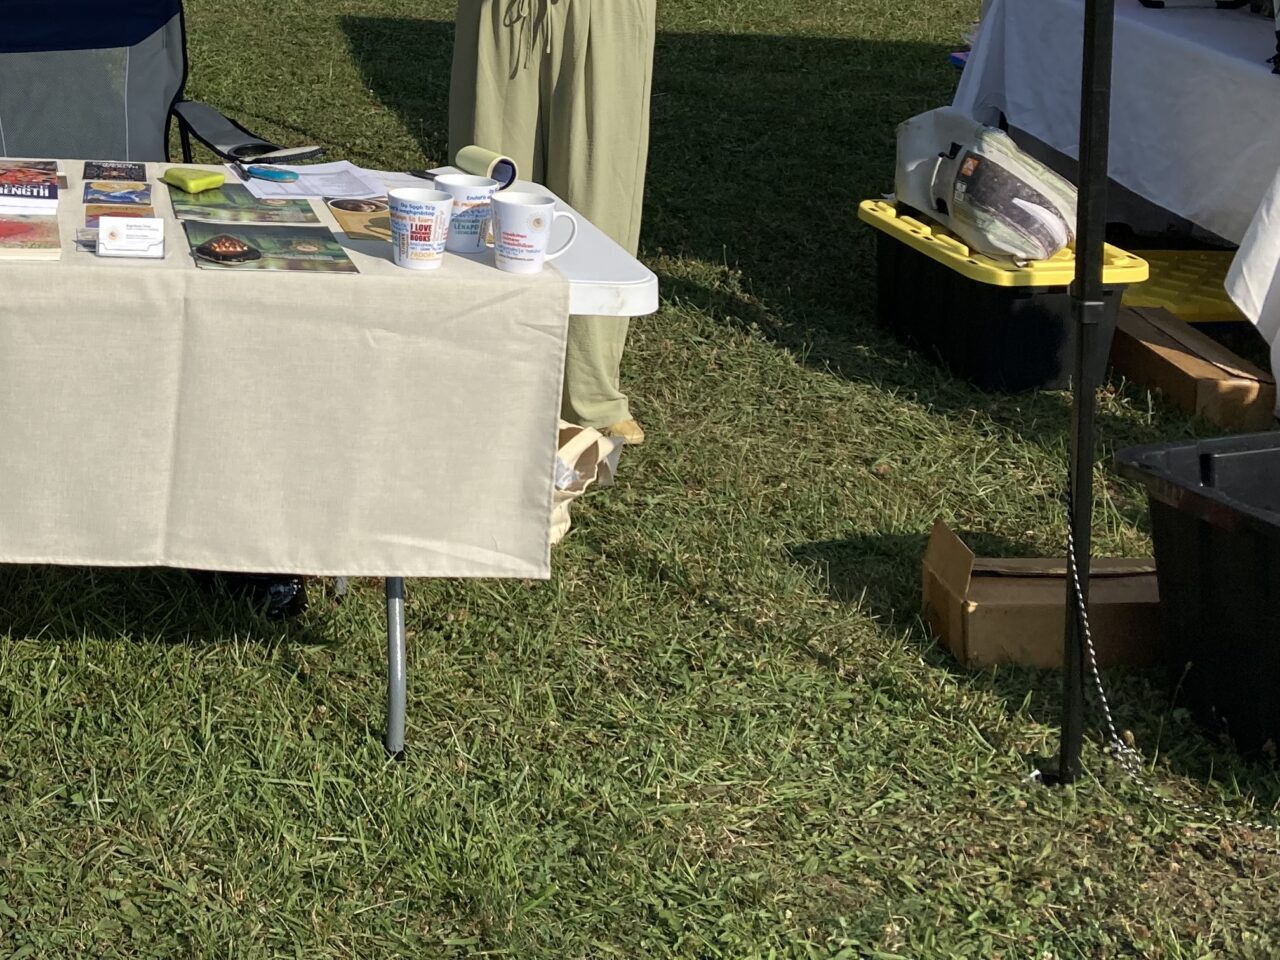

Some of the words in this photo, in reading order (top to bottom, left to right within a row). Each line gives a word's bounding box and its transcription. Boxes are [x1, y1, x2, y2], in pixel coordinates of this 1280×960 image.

[410, 223, 413, 231] I
[415, 224, 433, 232] LOVE
[410, 234, 431, 242] BOOKS
